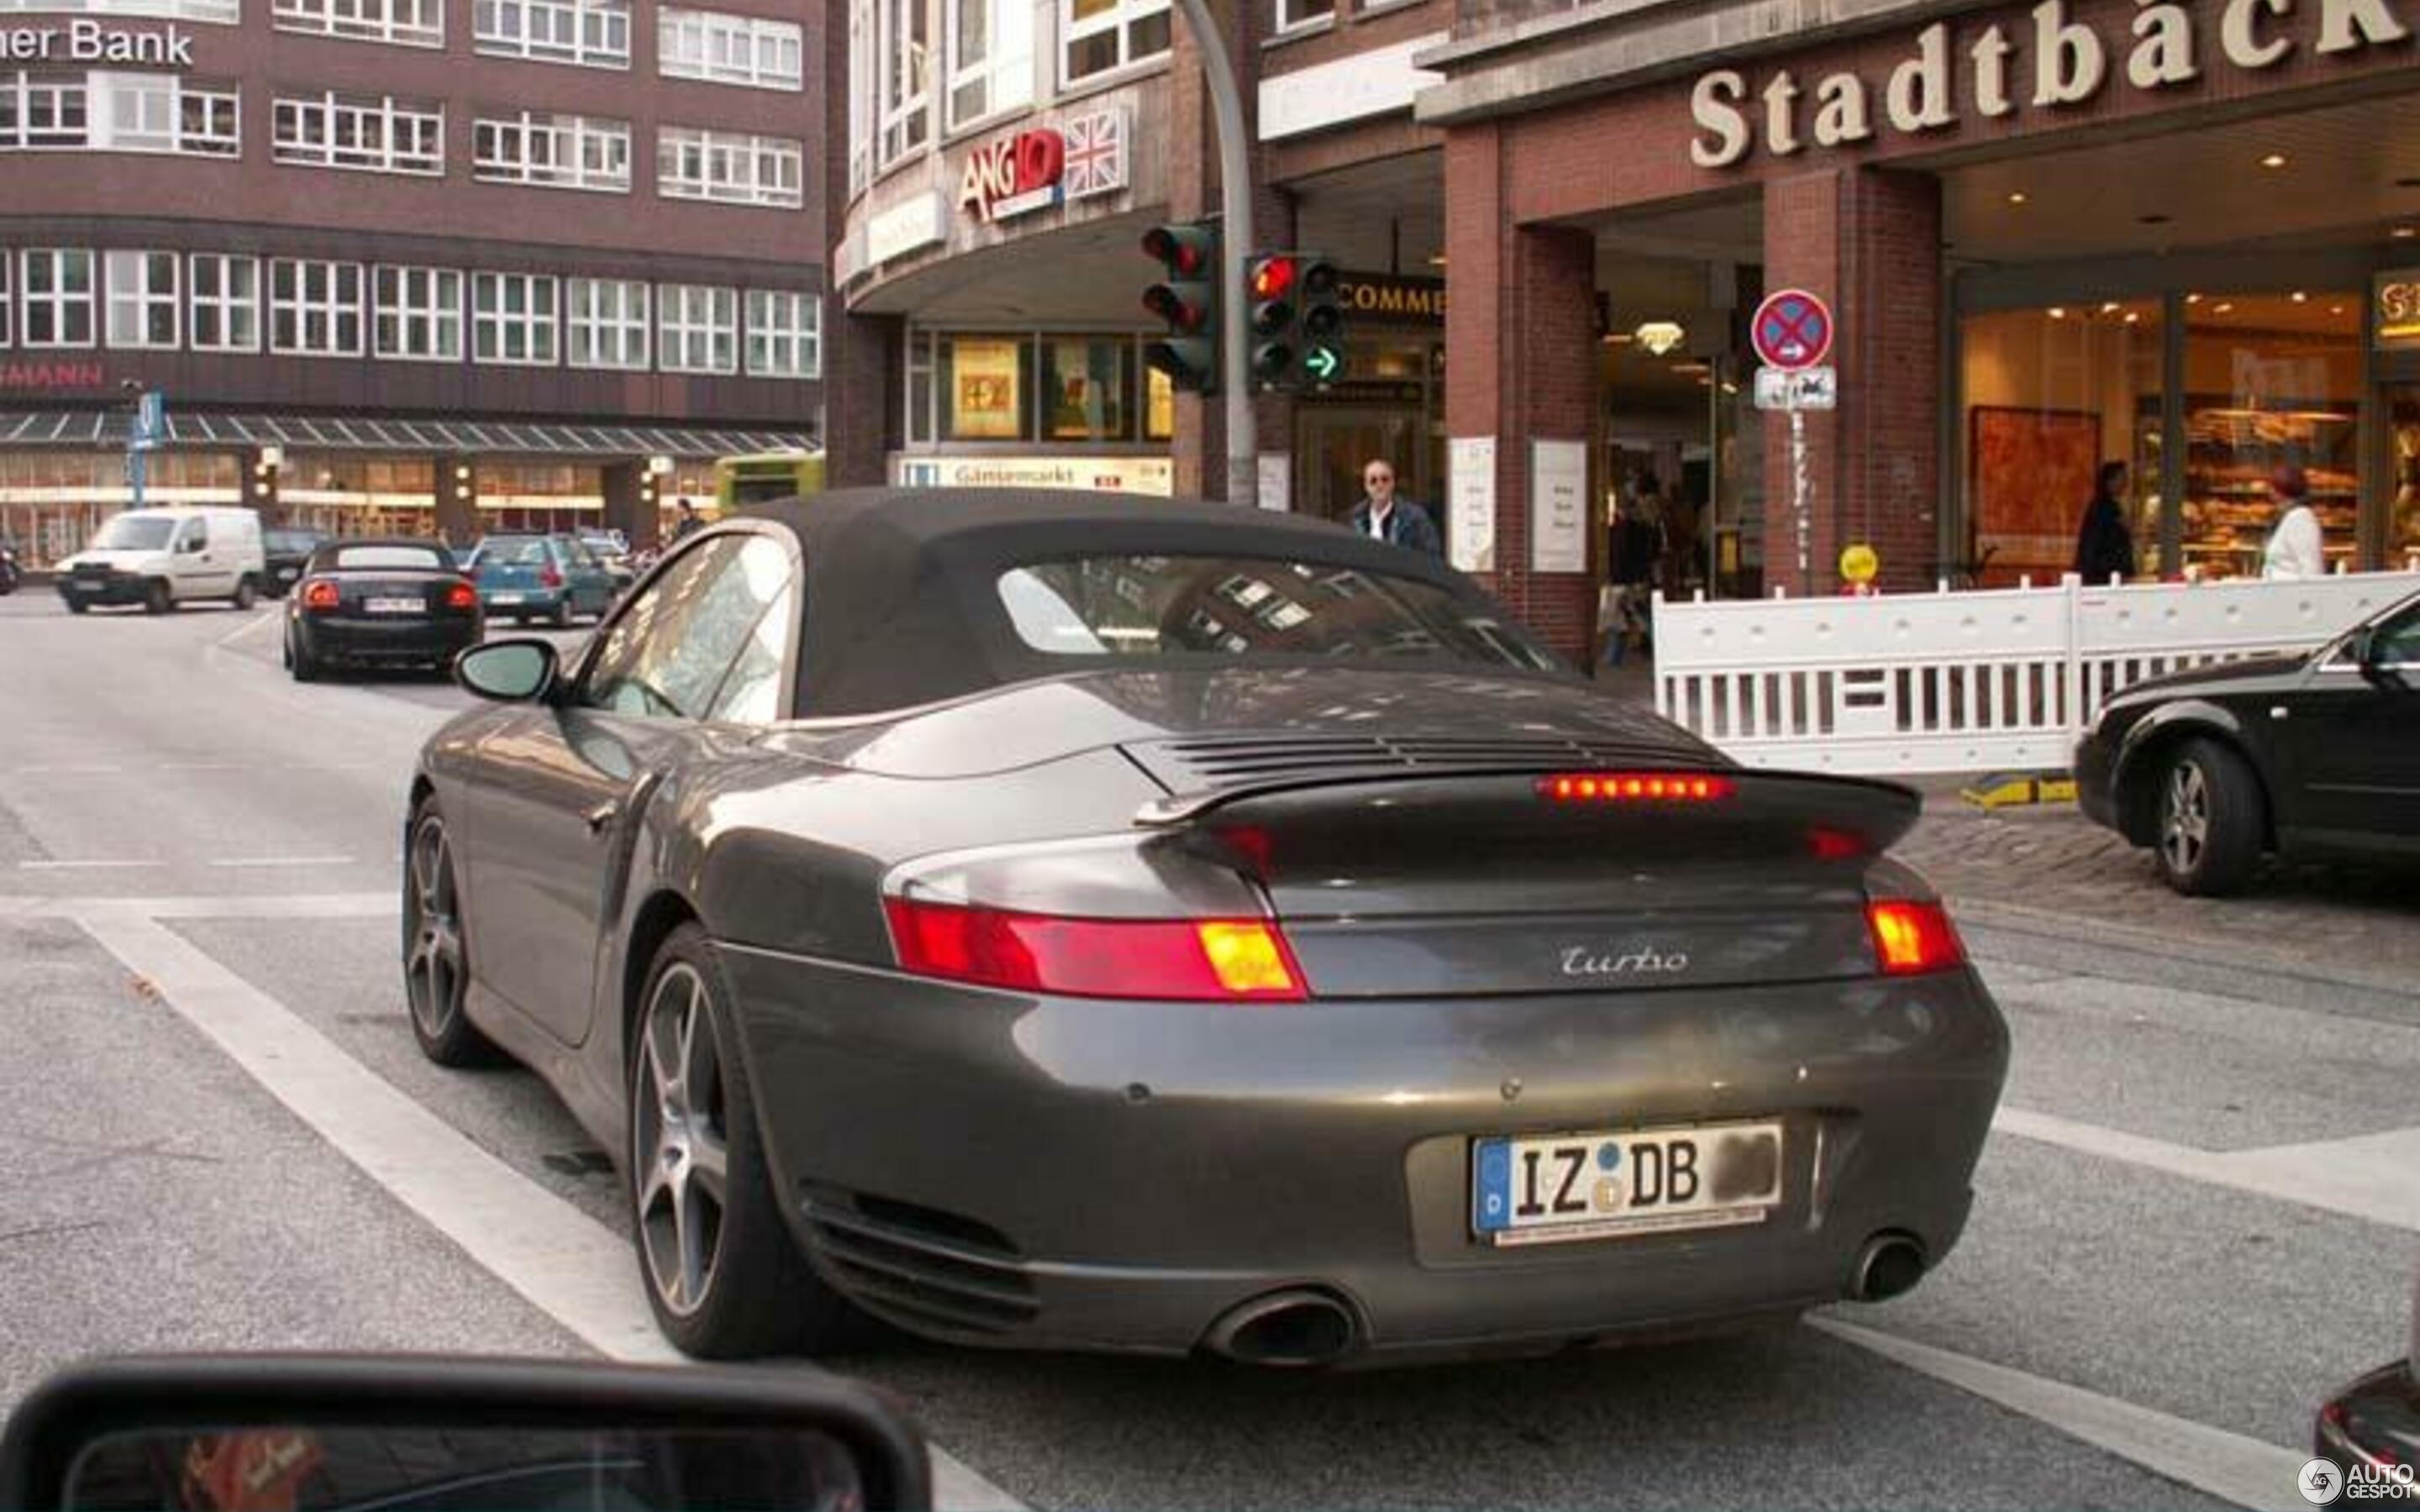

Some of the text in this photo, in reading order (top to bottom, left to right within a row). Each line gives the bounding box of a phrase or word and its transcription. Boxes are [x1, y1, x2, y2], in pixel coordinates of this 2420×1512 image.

[0, 19, 193, 65] er Bank
[0, 364, 102, 385] MANN
[1517, 1140, 1698, 1215] IZ DB
[1486, 1194, 1502, 1215] D
